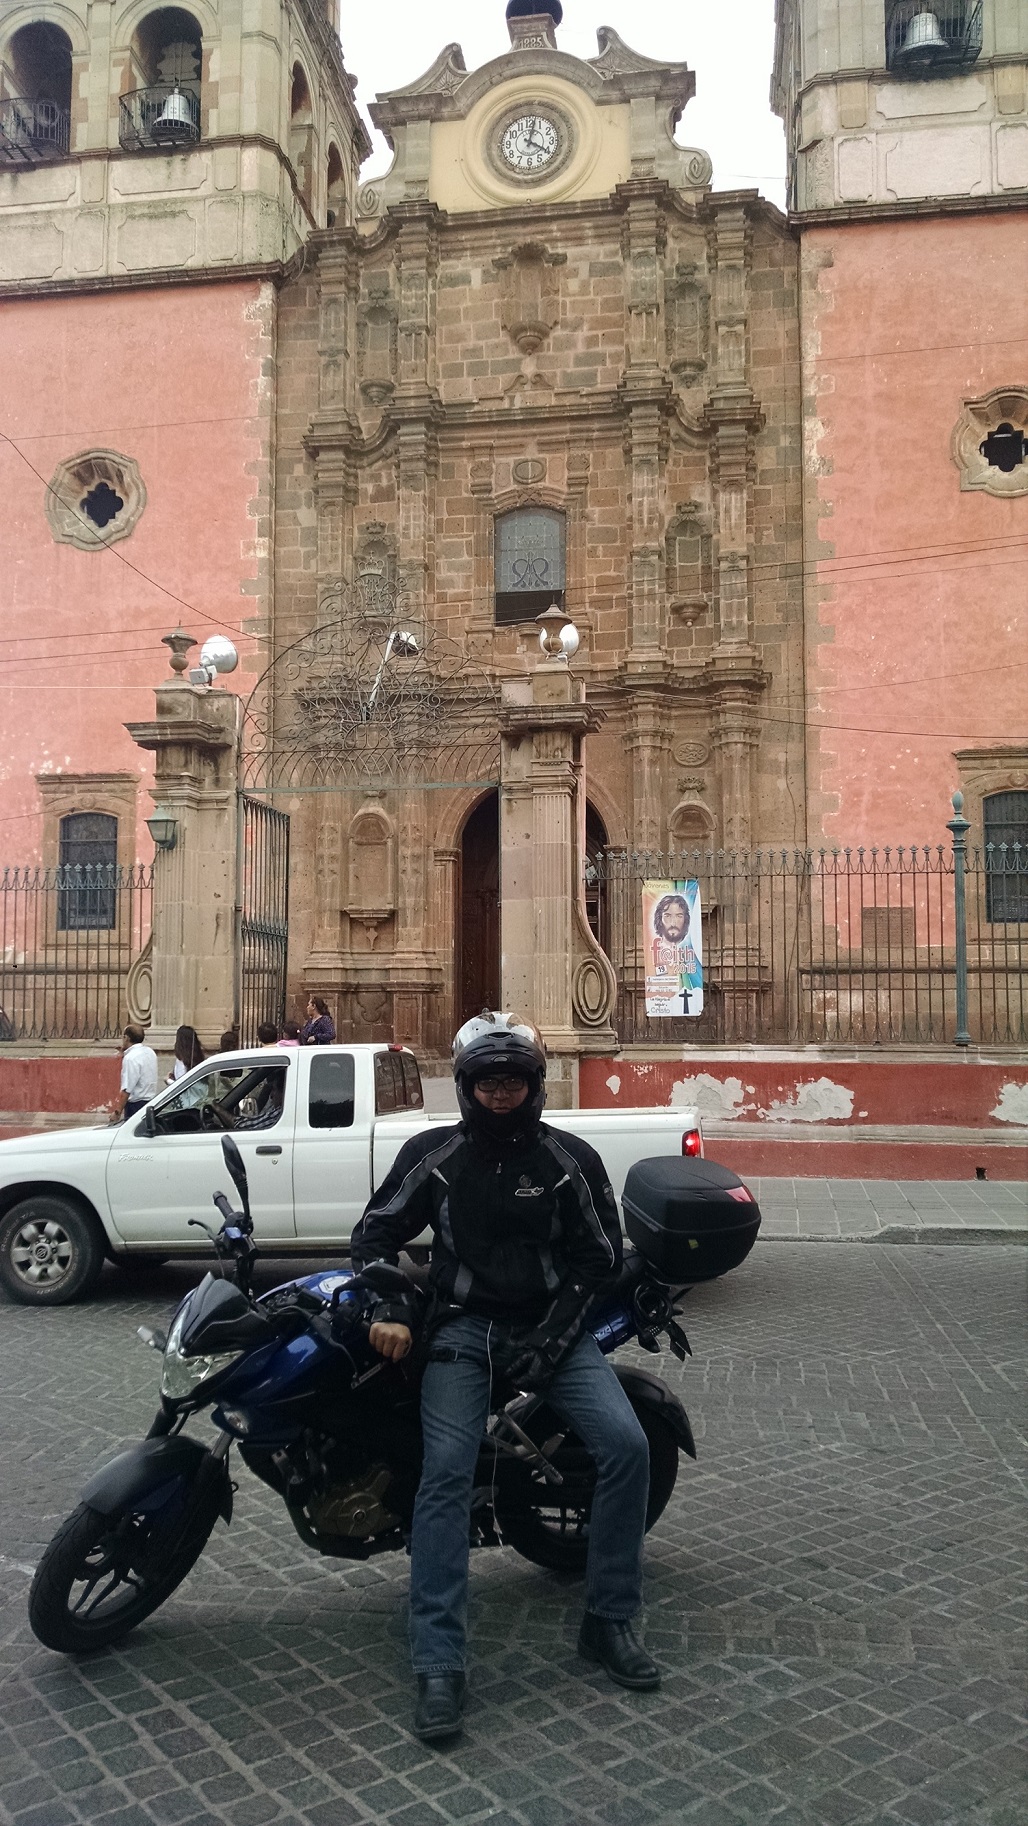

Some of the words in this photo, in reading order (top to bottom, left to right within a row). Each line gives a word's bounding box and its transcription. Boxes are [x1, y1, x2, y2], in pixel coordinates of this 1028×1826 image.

[517, 123, 524, 132] 11
[538, 120, 542, 130] 1
[509, 130, 518, 140] 10
[545, 127, 552, 136] 2
[505, 140, 512, 150] 9
[548, 136, 555, 146] 3
[508, 150, 515, 159] 8
[536, 154, 543, 163] 5
[516, 155, 523, 165] 7
[526, 157, 533, 167] 6
[657, 965, 666, 973] 19
